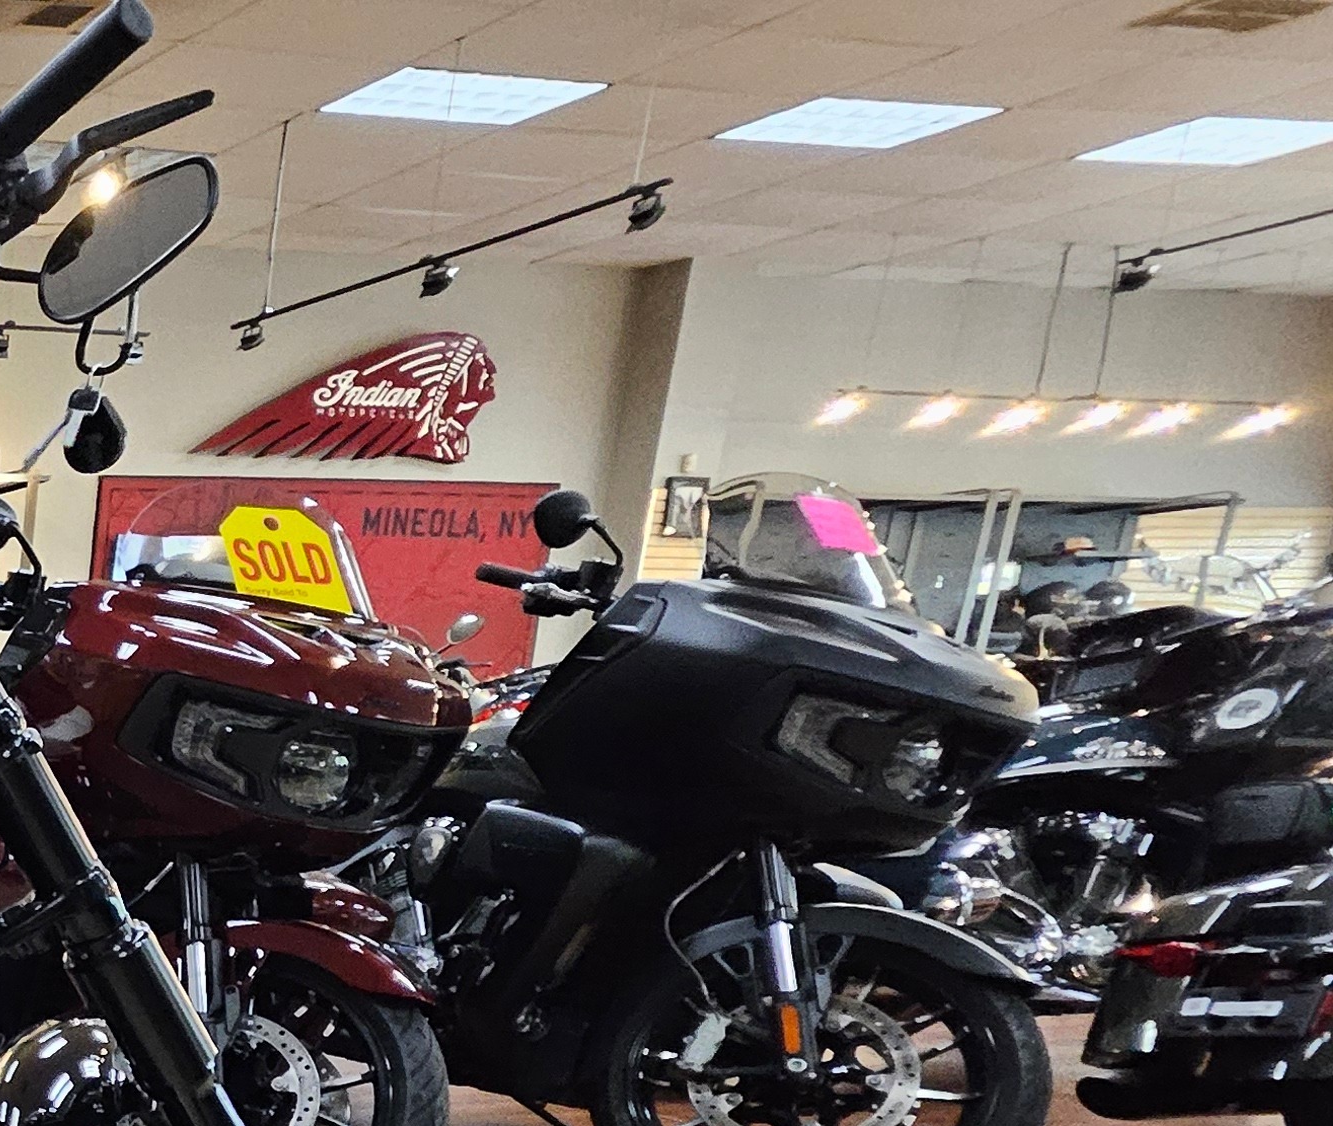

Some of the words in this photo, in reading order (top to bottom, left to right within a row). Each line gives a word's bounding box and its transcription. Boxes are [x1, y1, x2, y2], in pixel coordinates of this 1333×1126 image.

[313, 369, 422, 407] Indian
[361, 507, 486, 543] MINEOLA,
[498, 510, 535, 539] NY
[232, 538, 332, 586] SOLD
